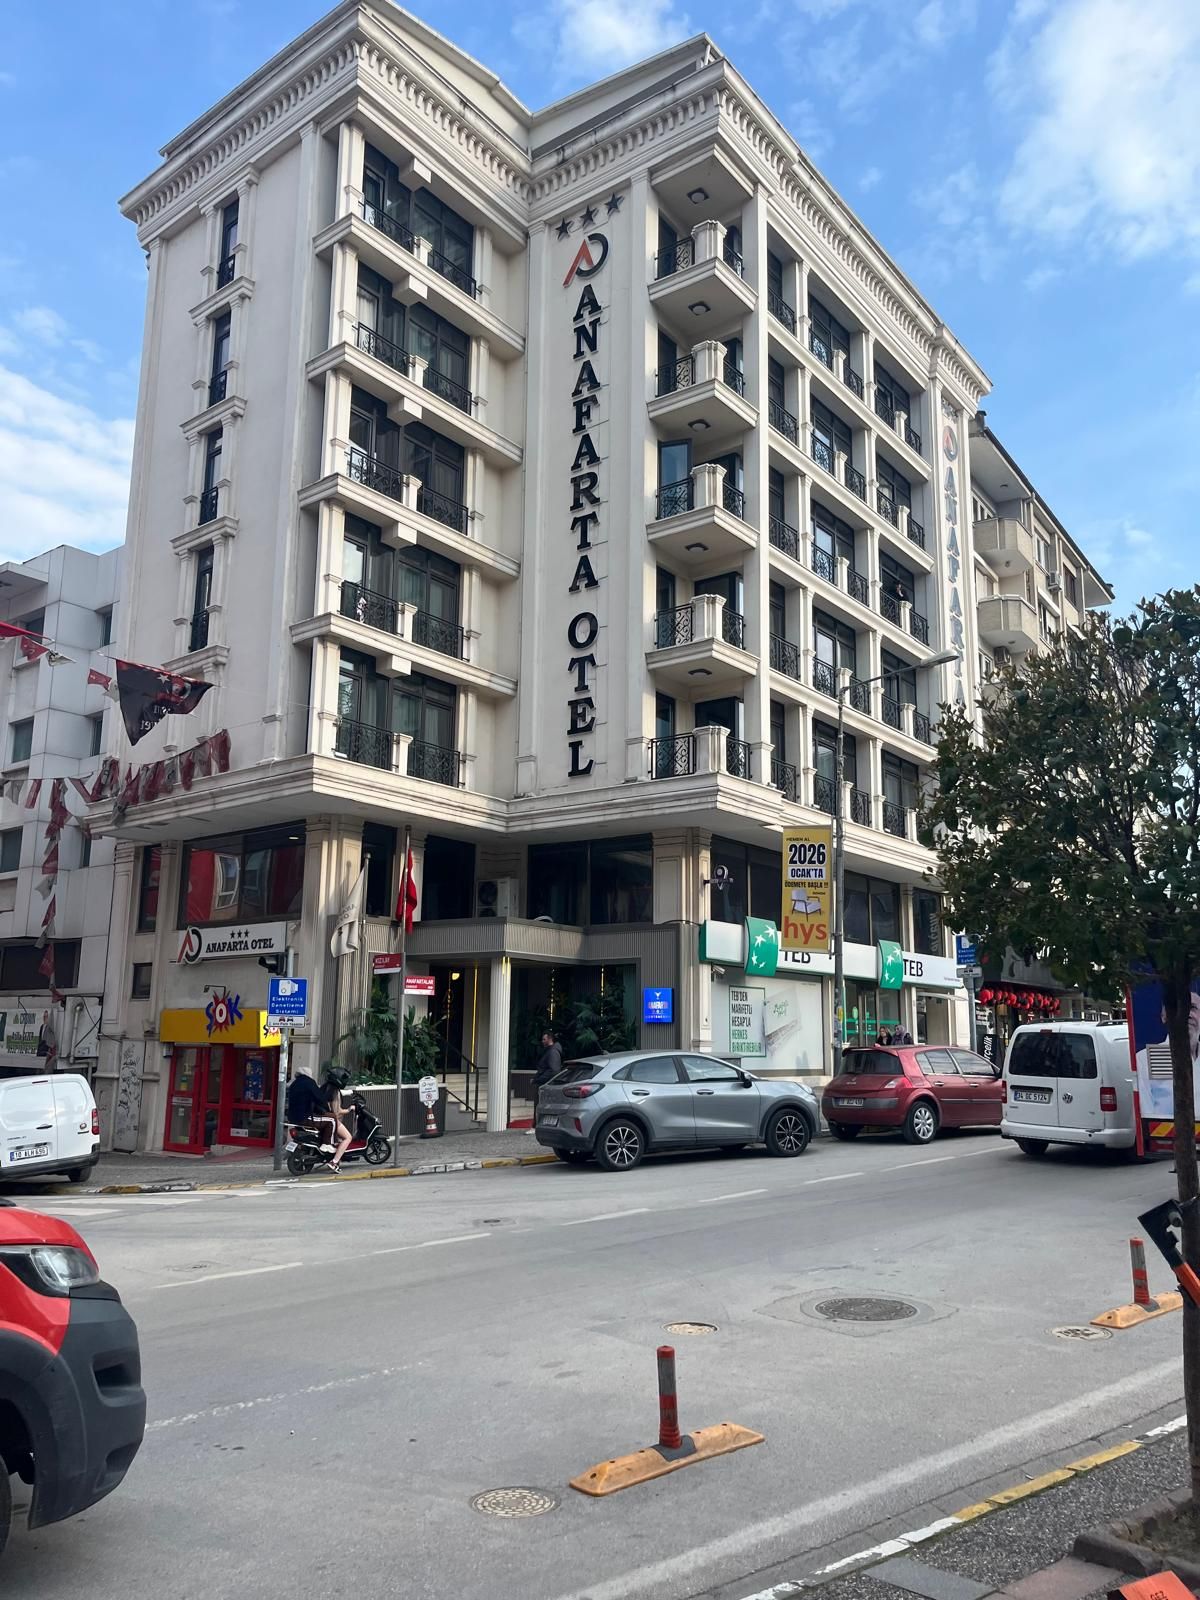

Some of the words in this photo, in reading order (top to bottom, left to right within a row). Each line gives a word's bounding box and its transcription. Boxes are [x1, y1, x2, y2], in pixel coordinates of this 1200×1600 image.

[567, 284, 602, 593] ANAFARTA
[567, 611, 599, 778] OTEL
[788, 843, 826, 865] 2026
[790, 868, 824, 878] OCAK'TA
[784, 915, 827, 945] hys
[206, 939, 249, 953] ANAFARTA
[250, 938, 274, 950] OTEL
[903, 958, 924, 977] TEB
